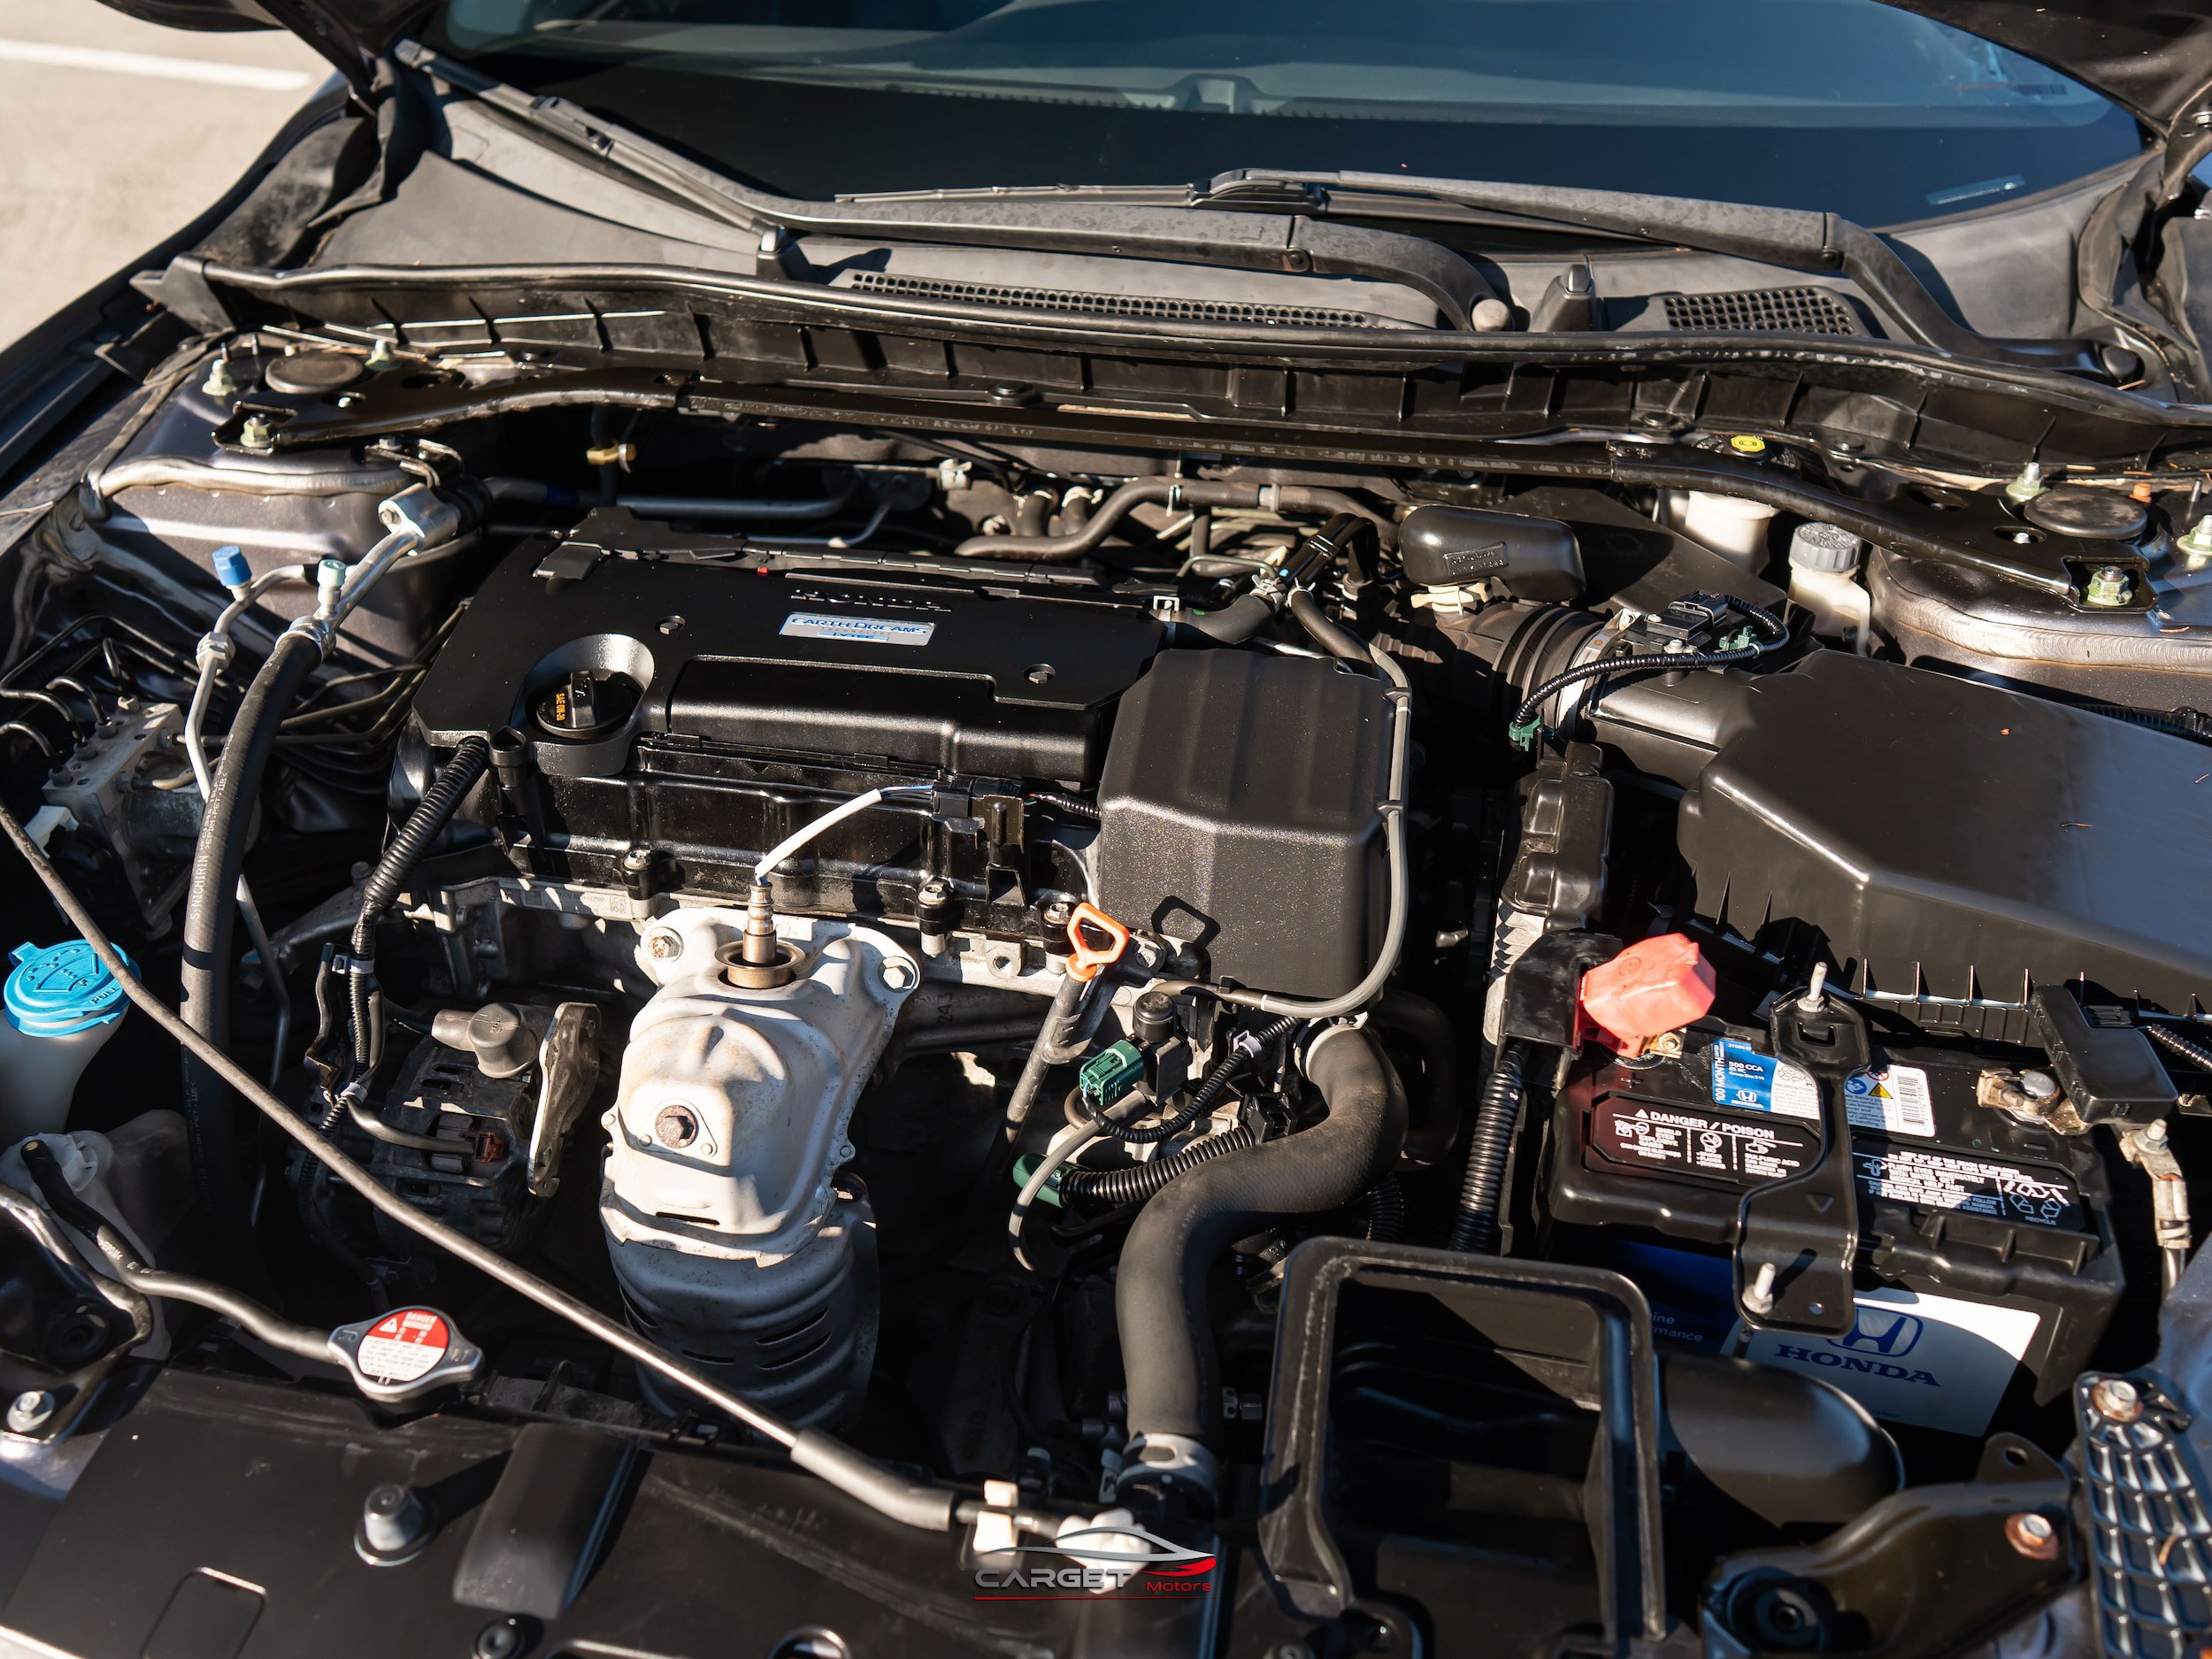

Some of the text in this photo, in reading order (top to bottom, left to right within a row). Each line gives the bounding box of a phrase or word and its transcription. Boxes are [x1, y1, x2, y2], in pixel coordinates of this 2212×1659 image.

[791, 618, 927, 634] EARTH DREAMS
[821, 626, 892, 636] TECHNOLOGY
[556, 693, 565, 721] SAE 0W-20
[1729, 1061, 1764, 1072] 500 CCA
[1714, 1057, 1726, 1102] 100 MONTH
[1731, 1099, 1764, 1109] HONDA
[1650, 1110, 1709, 1129] DANGER
[1722, 1122, 1776, 1140] POISON
[1655, 1126, 1682, 1137] SHIELD
[1639, 1134, 1679, 1147] EXPLOSIVE
[1655, 1132, 1675, 1141] EYES
[1781, 1158, 1801, 1168] ACID
[1887, 1162, 1985, 1184] FLUSH EYES IMMEDIATELY
[1888, 1168, 1909, 1179] WITH
[1939, 1175, 1956, 1185] GET
[1888, 1174, 1924, 1186] MEDICAL
[1923, 1179, 1945, 1189] HELP
[1944, 1182, 1965, 1193] FAST
[1961, 1203, 1998, 1216] ASSISTANCE
[2024, 1214, 2057, 1226] RECYCLE
[1651, 1310, 1677, 1325] ine
[1654, 1326, 1704, 1343] mance
[1774, 1342, 1942, 1387] HONDA
